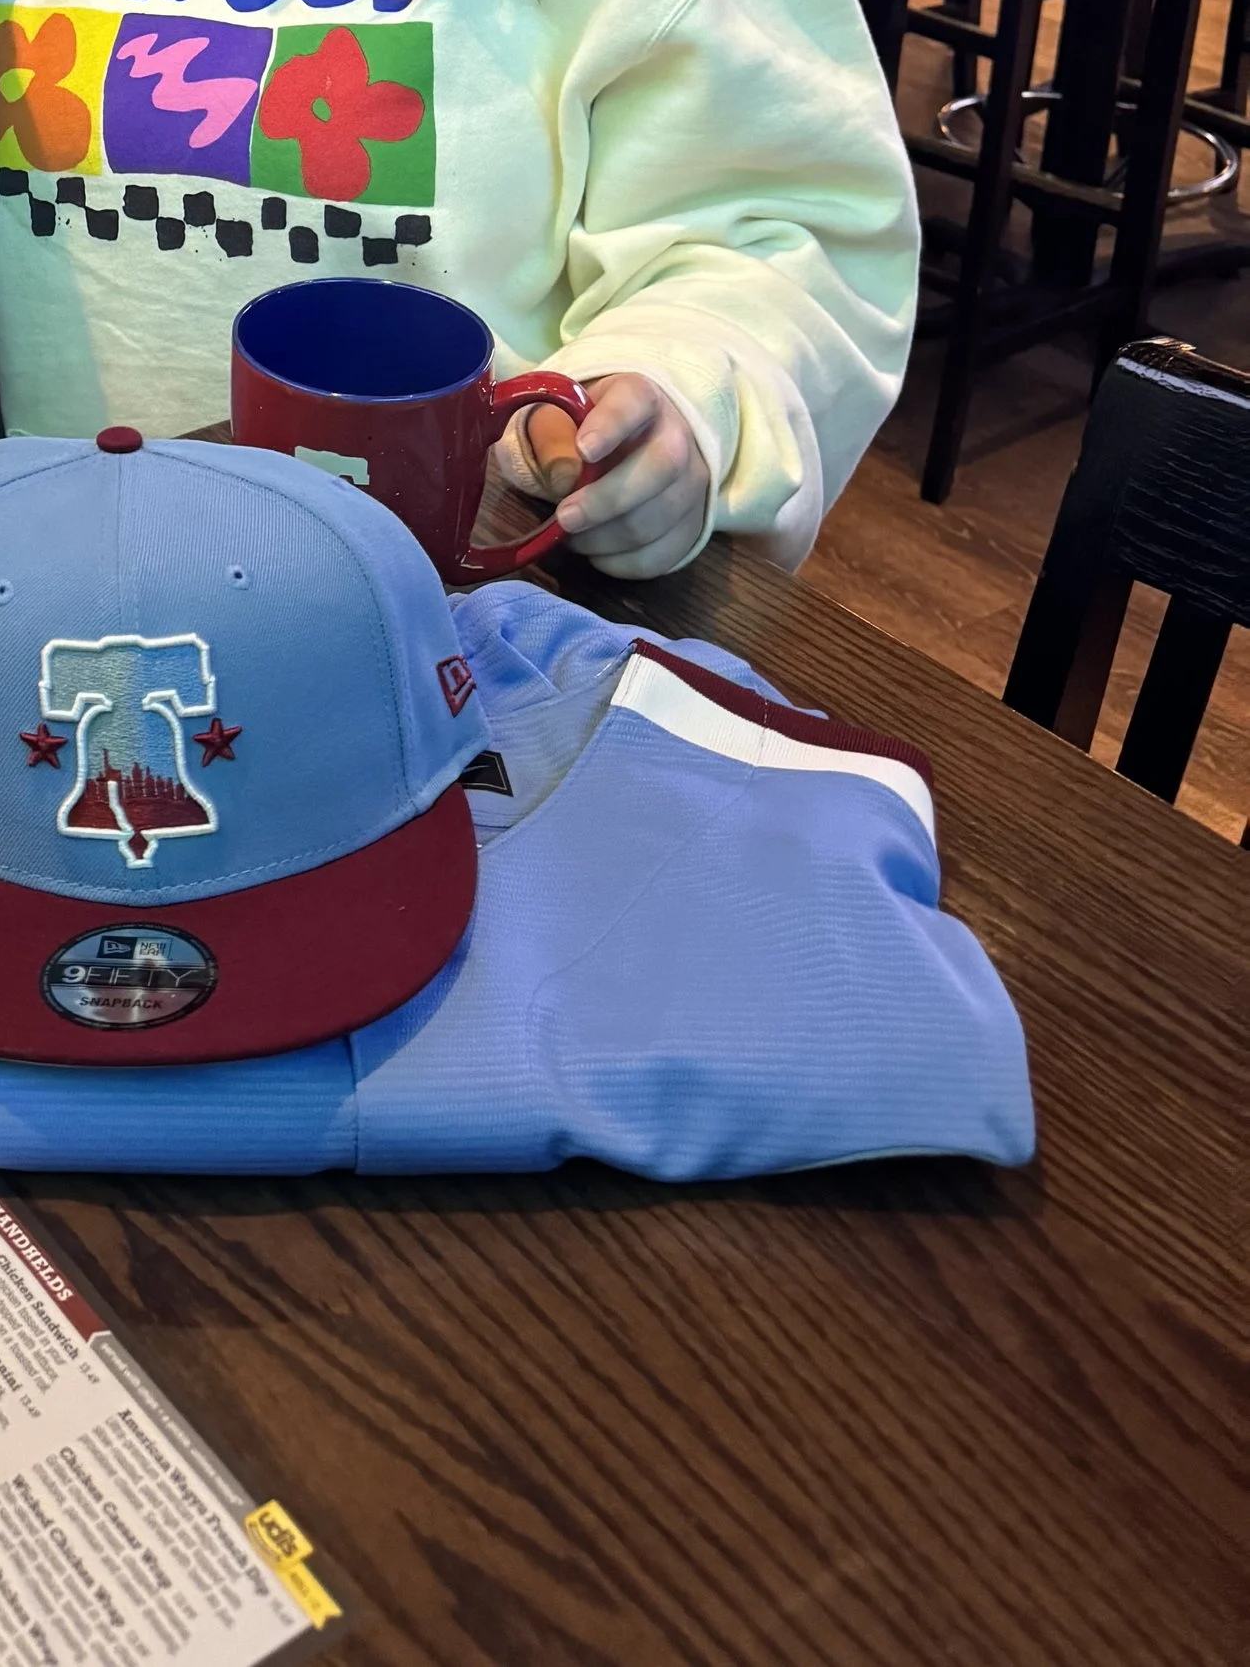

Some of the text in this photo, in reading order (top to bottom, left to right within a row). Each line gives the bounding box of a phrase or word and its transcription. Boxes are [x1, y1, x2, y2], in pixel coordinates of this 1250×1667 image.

[61, 965, 200, 988] 9FIFTY
[79, 996, 164, 1010] SNAPBACK
[29, 1300, 81, 1360] Sandwich
